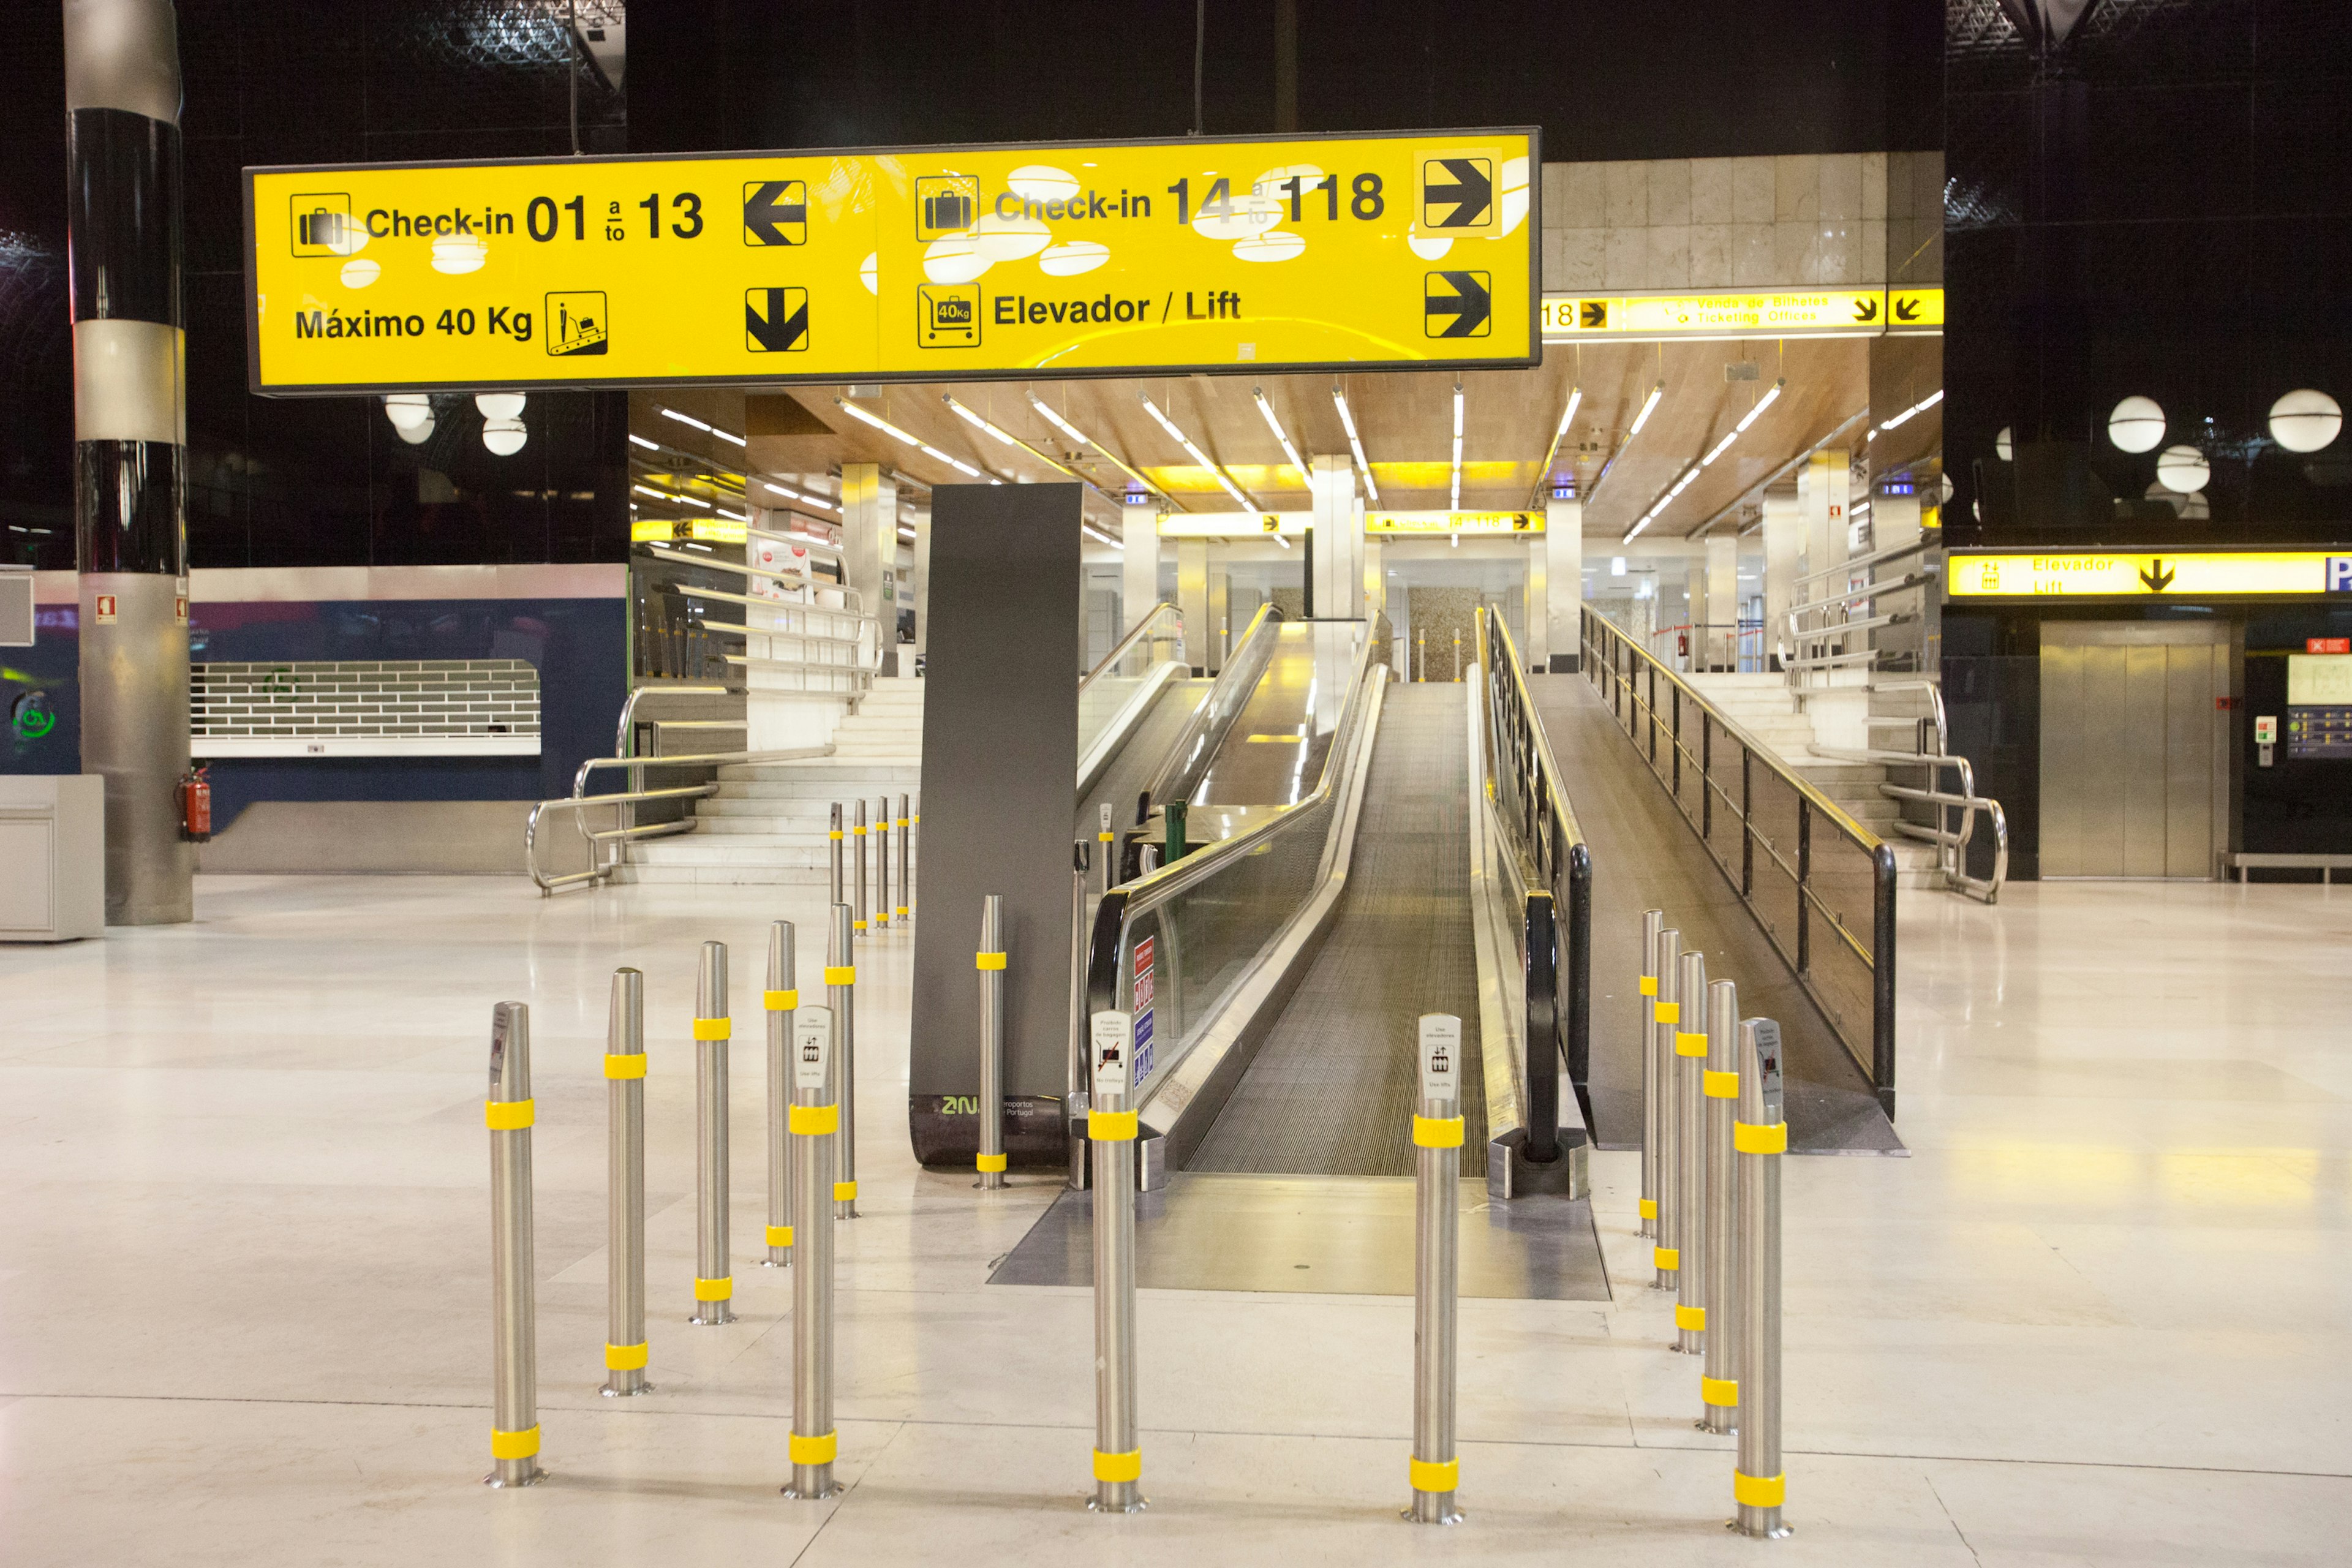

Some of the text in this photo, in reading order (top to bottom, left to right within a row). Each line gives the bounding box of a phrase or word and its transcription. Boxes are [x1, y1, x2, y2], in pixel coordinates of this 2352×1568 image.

[995, 189, 1151, 221] Check-in
[1167, 177, 1234, 224] 14
[1281, 173, 1384, 222] 118
[366, 192, 703, 242] Check-in 01 a to 13
[995, 293, 1150, 324] Elevador
[1187, 291, 1240, 319] Lift
[1697, 295, 1829, 309] Venda de Bilhetes
[296, 306, 532, 341] Máximo 40 Kg
[1697, 310, 1817, 325] Ticketing Offices
[1475, 516, 1500, 527] 118
[2033, 557, 2114, 571] Elevador
[2034, 579, 2063, 594] Lift
[1006, 1109, 1033, 1118] Portugal
